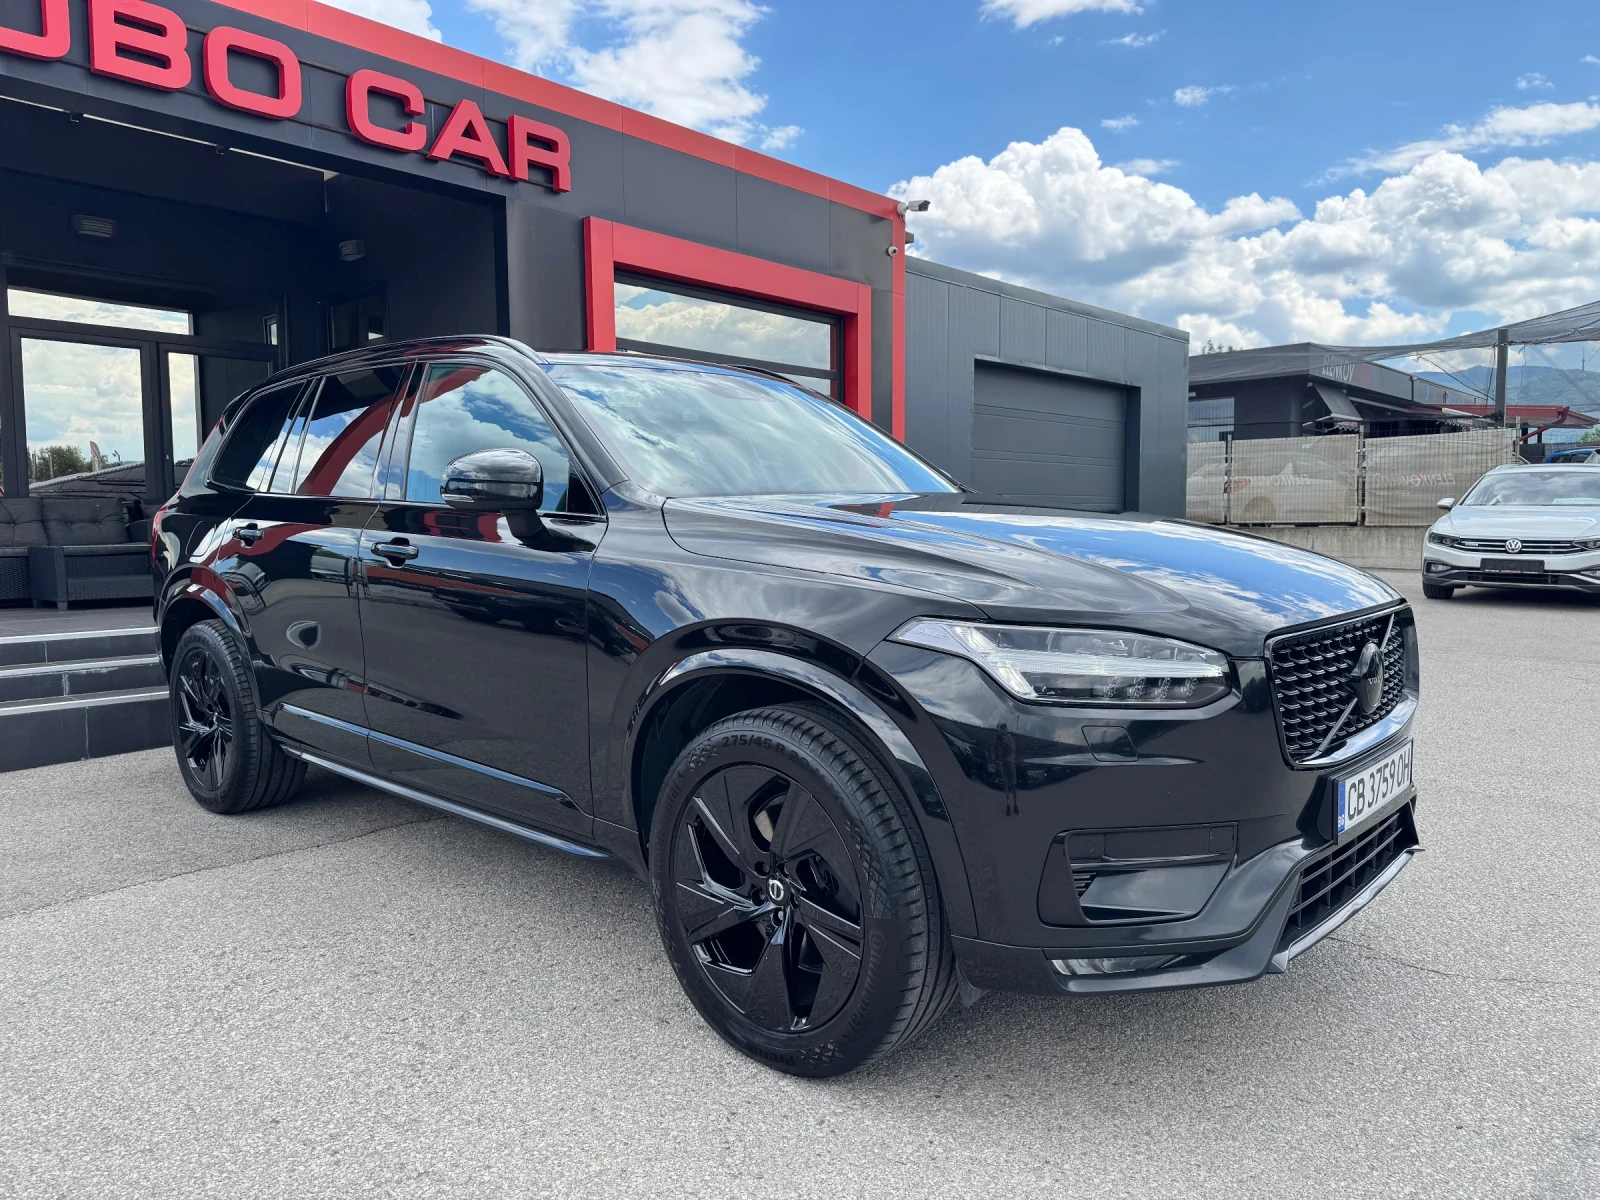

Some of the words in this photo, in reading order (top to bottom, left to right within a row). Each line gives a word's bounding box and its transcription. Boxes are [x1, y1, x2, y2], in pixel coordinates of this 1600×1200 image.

[346, 69, 571, 193] CAR
[722, 734, 773, 750] 275/45
[1347, 777, 1366, 821] CB
[1367, 758, 1396, 809] 3759
[1397, 747, 1411, 788] OH
